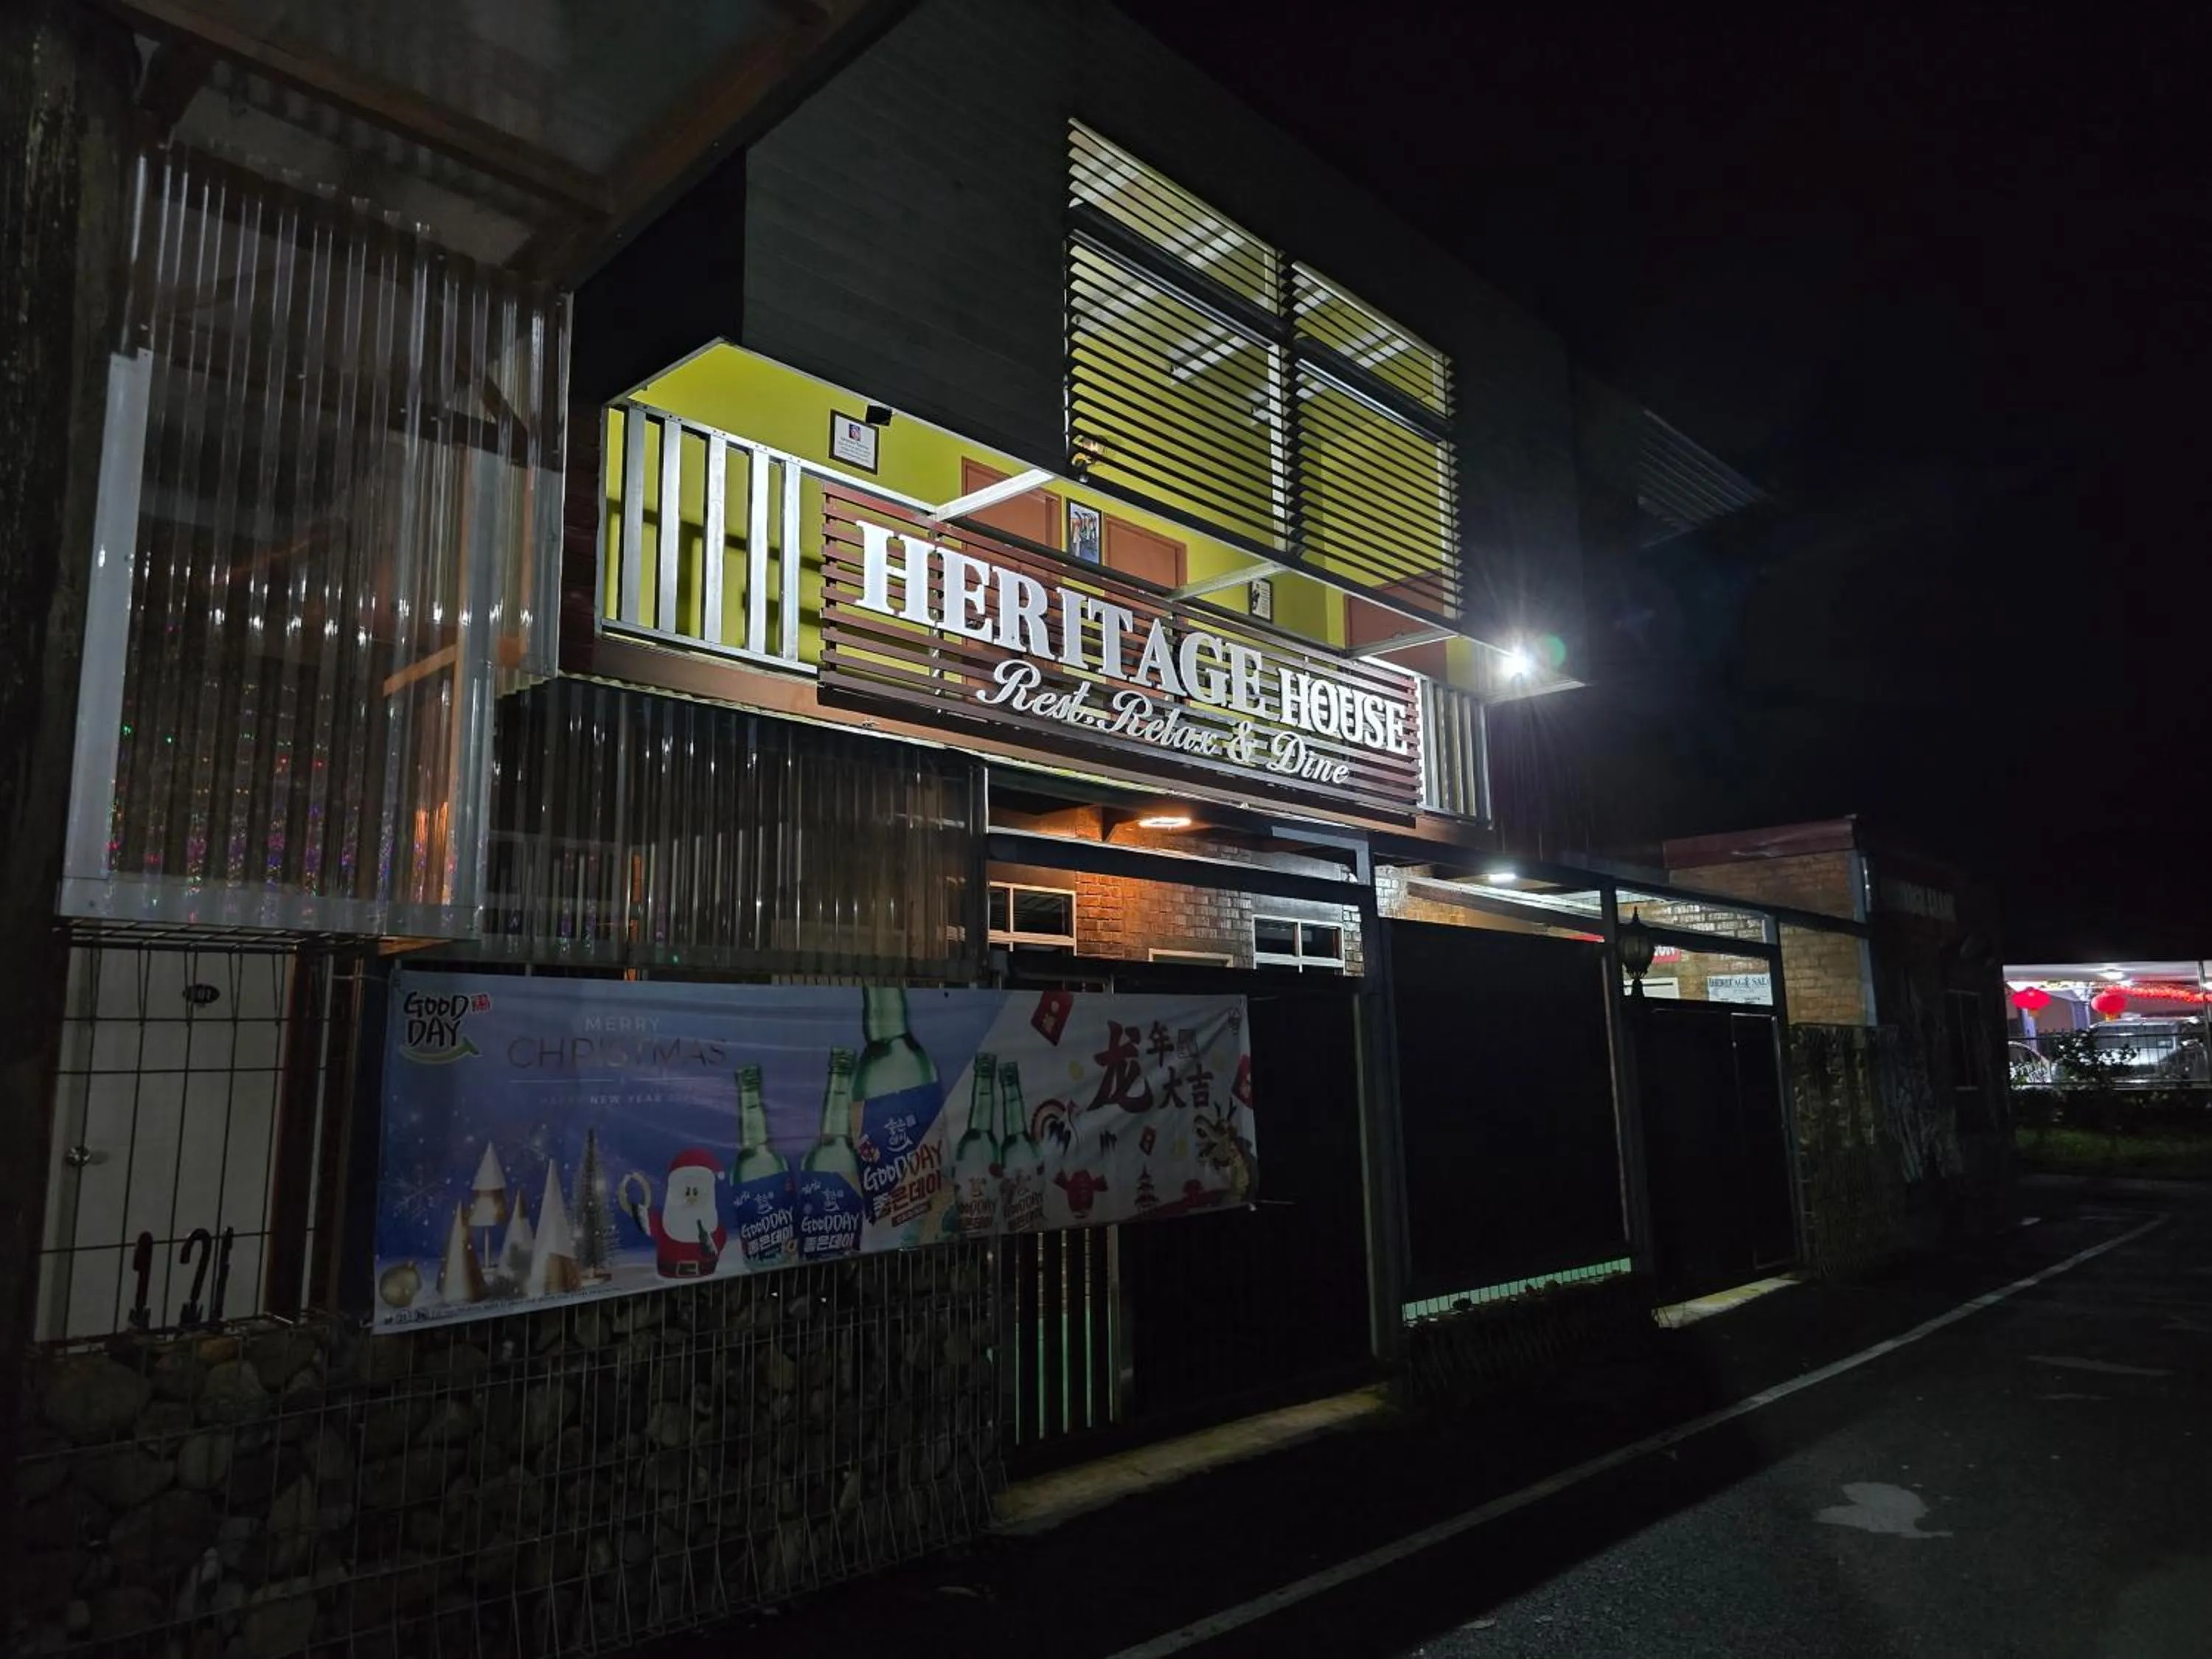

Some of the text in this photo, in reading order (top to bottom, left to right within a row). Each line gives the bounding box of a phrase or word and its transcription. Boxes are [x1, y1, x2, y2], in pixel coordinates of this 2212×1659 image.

[855, 519, 1408, 756] HERITAGE HOUSE
[1096, 689, 1222, 756] Relax
[1227, 720, 1255, 765] &
[1266, 731, 1349, 784] Dine
[403, 991, 470, 1021] GOOD
[407, 1016, 462, 1048] DAY
[584, 1015, 661, 1032] MERRY
